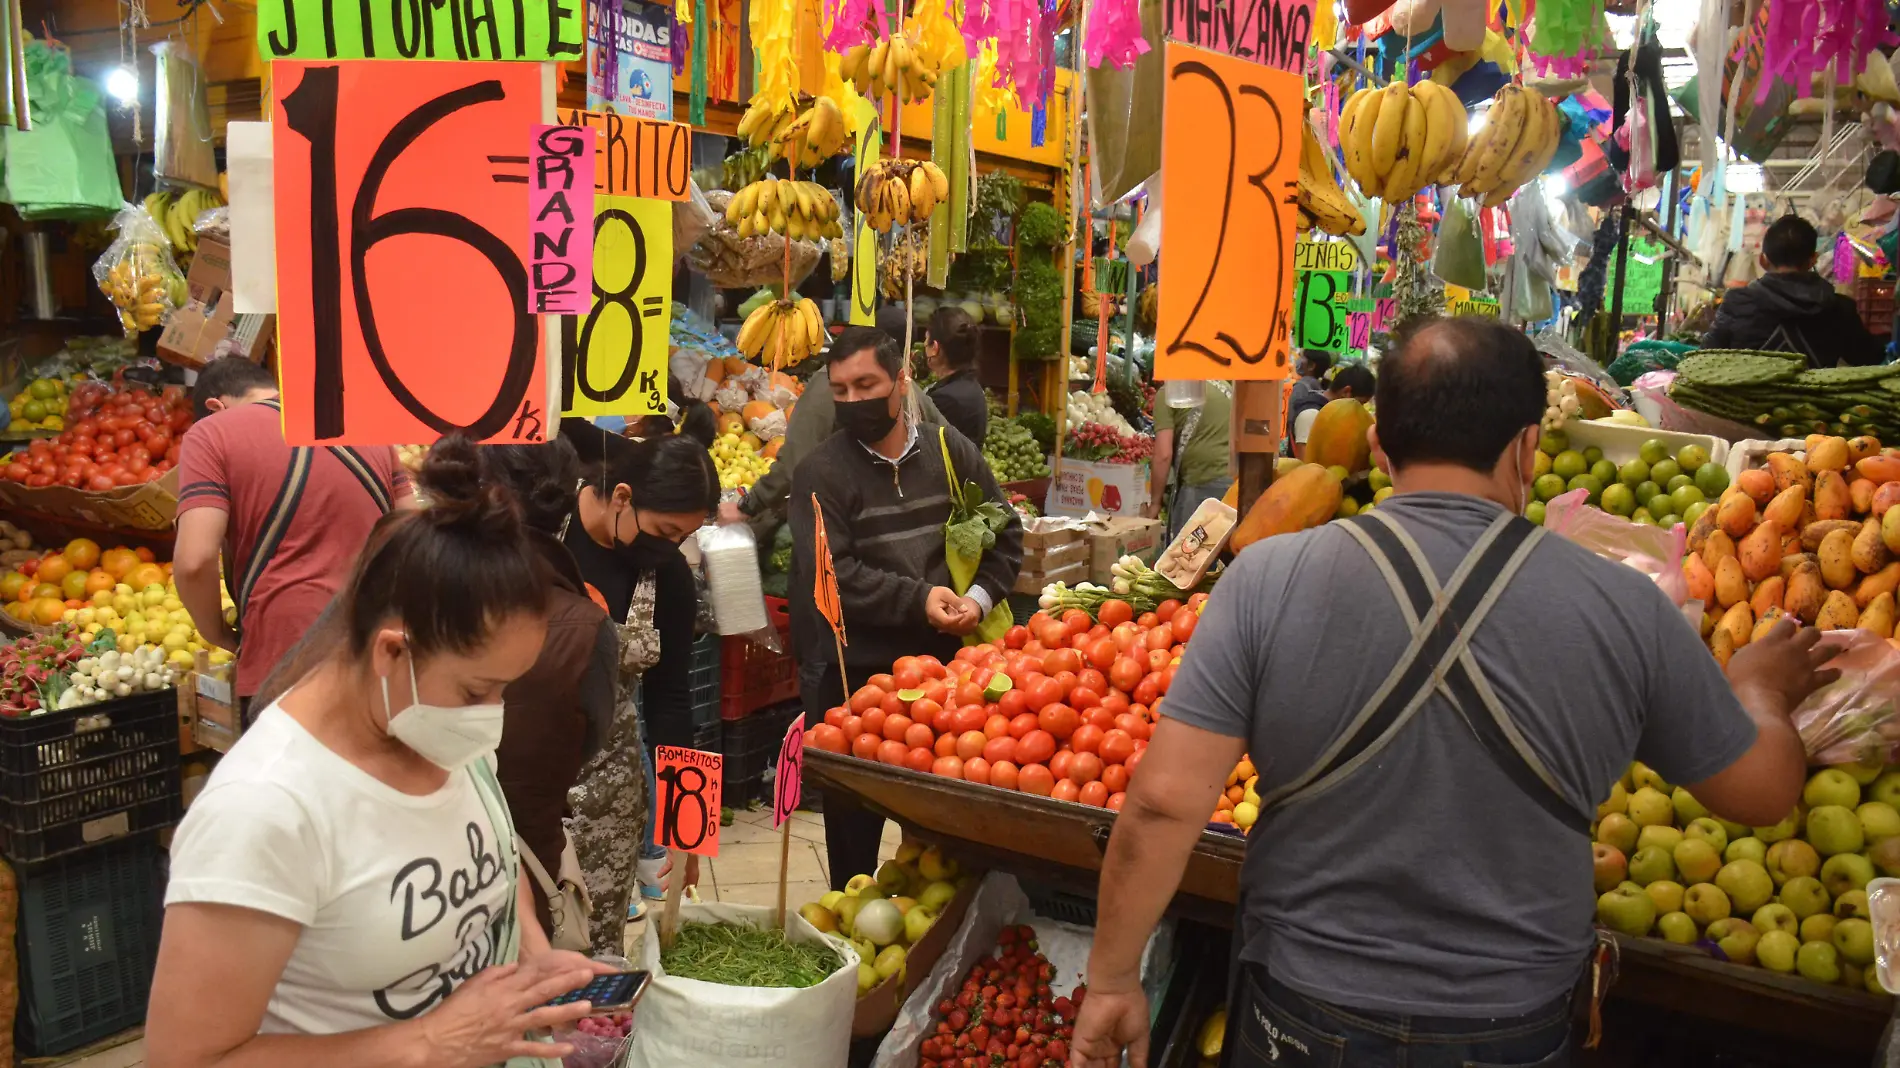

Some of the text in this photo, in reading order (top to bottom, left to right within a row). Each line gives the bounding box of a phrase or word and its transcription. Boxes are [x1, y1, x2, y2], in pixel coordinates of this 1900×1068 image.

[1166, 0, 1311, 75] MANZANA
[533, 126, 585, 314] GRANDE
[1294, 243, 1353, 270] PIÑAS
[1299, 271, 1337, 348] 13
[658, 746, 721, 770] ROMERITOS
[657, 765, 708, 850] 18
[390, 821, 506, 941] Bab
